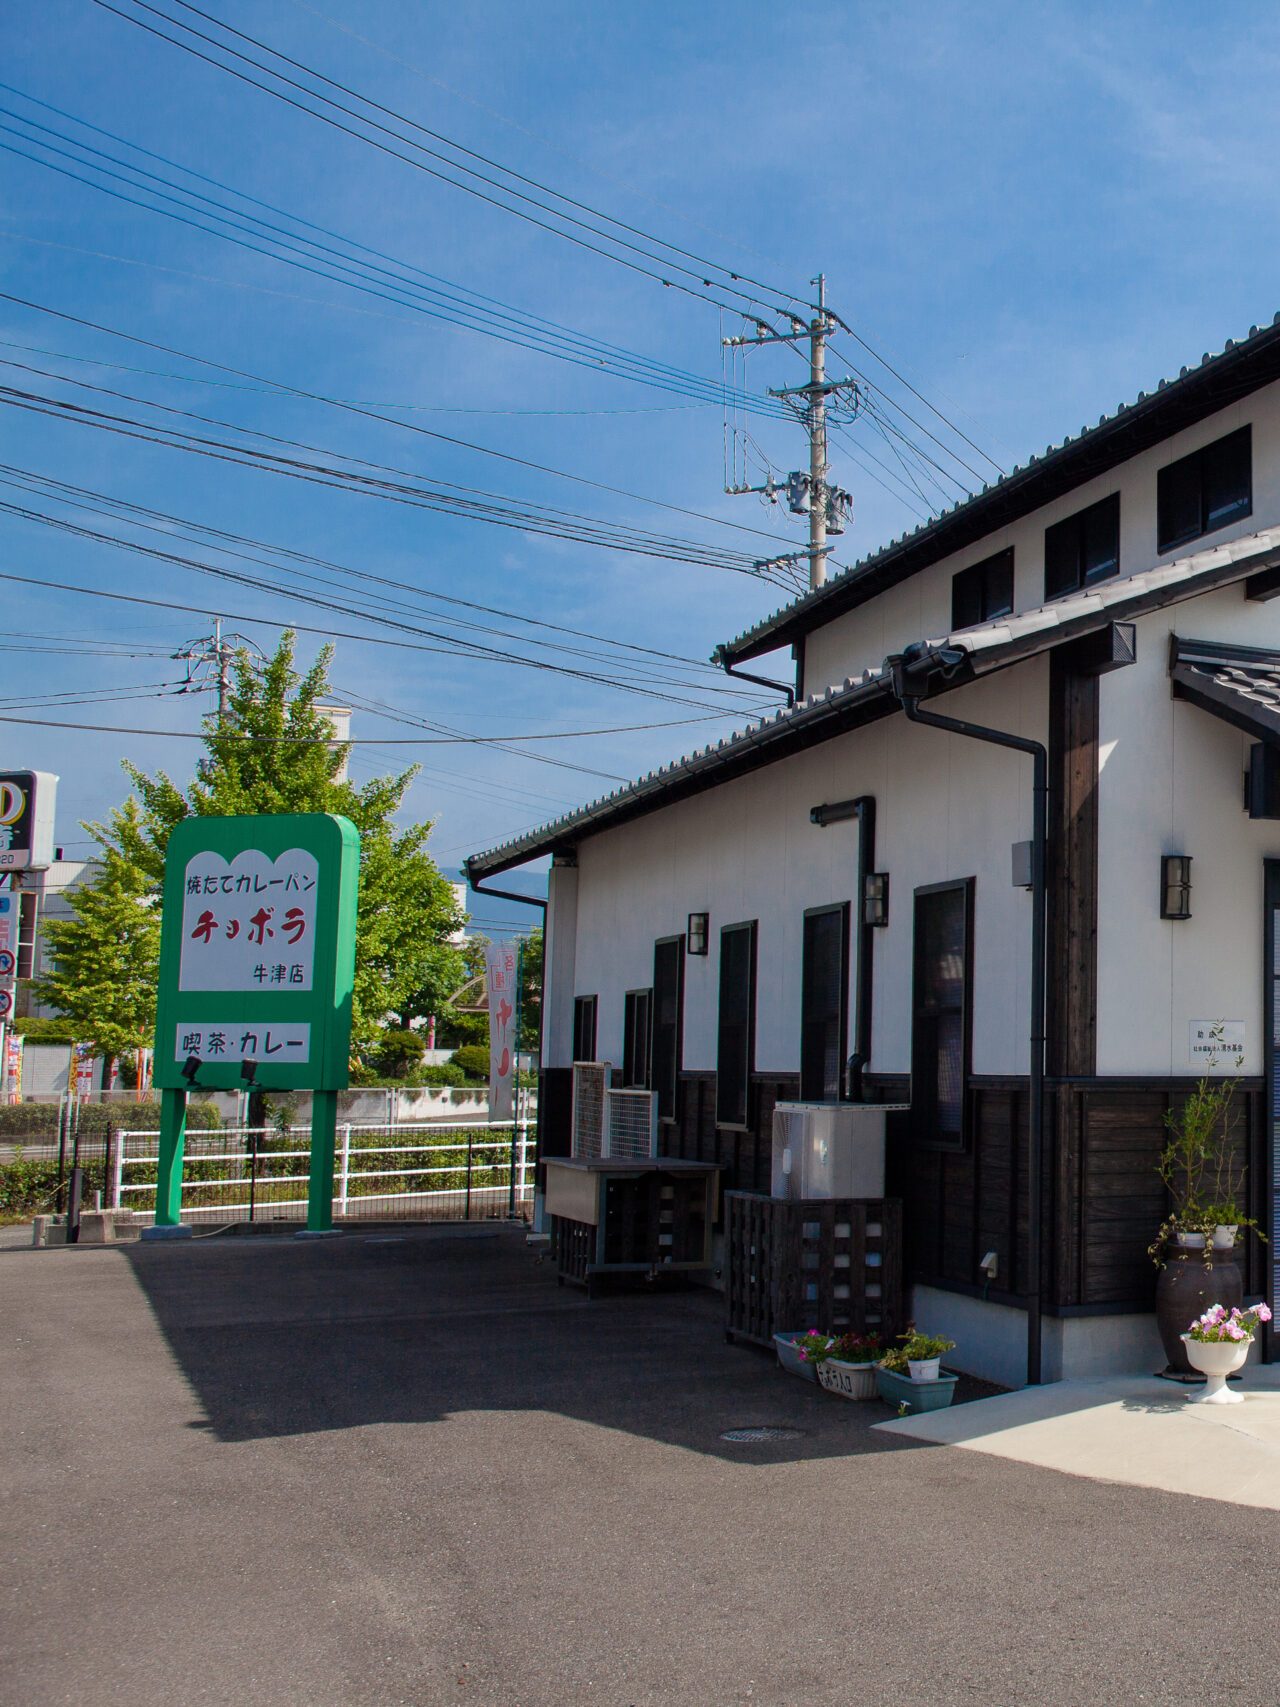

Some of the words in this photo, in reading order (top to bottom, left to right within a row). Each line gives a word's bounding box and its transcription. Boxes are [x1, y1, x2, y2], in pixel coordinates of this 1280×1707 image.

[187, 872, 316, 895] 焼たてカレーパン
[191, 906, 306, 946] チョボラ
[253, 963, 305, 984] 牛津店
